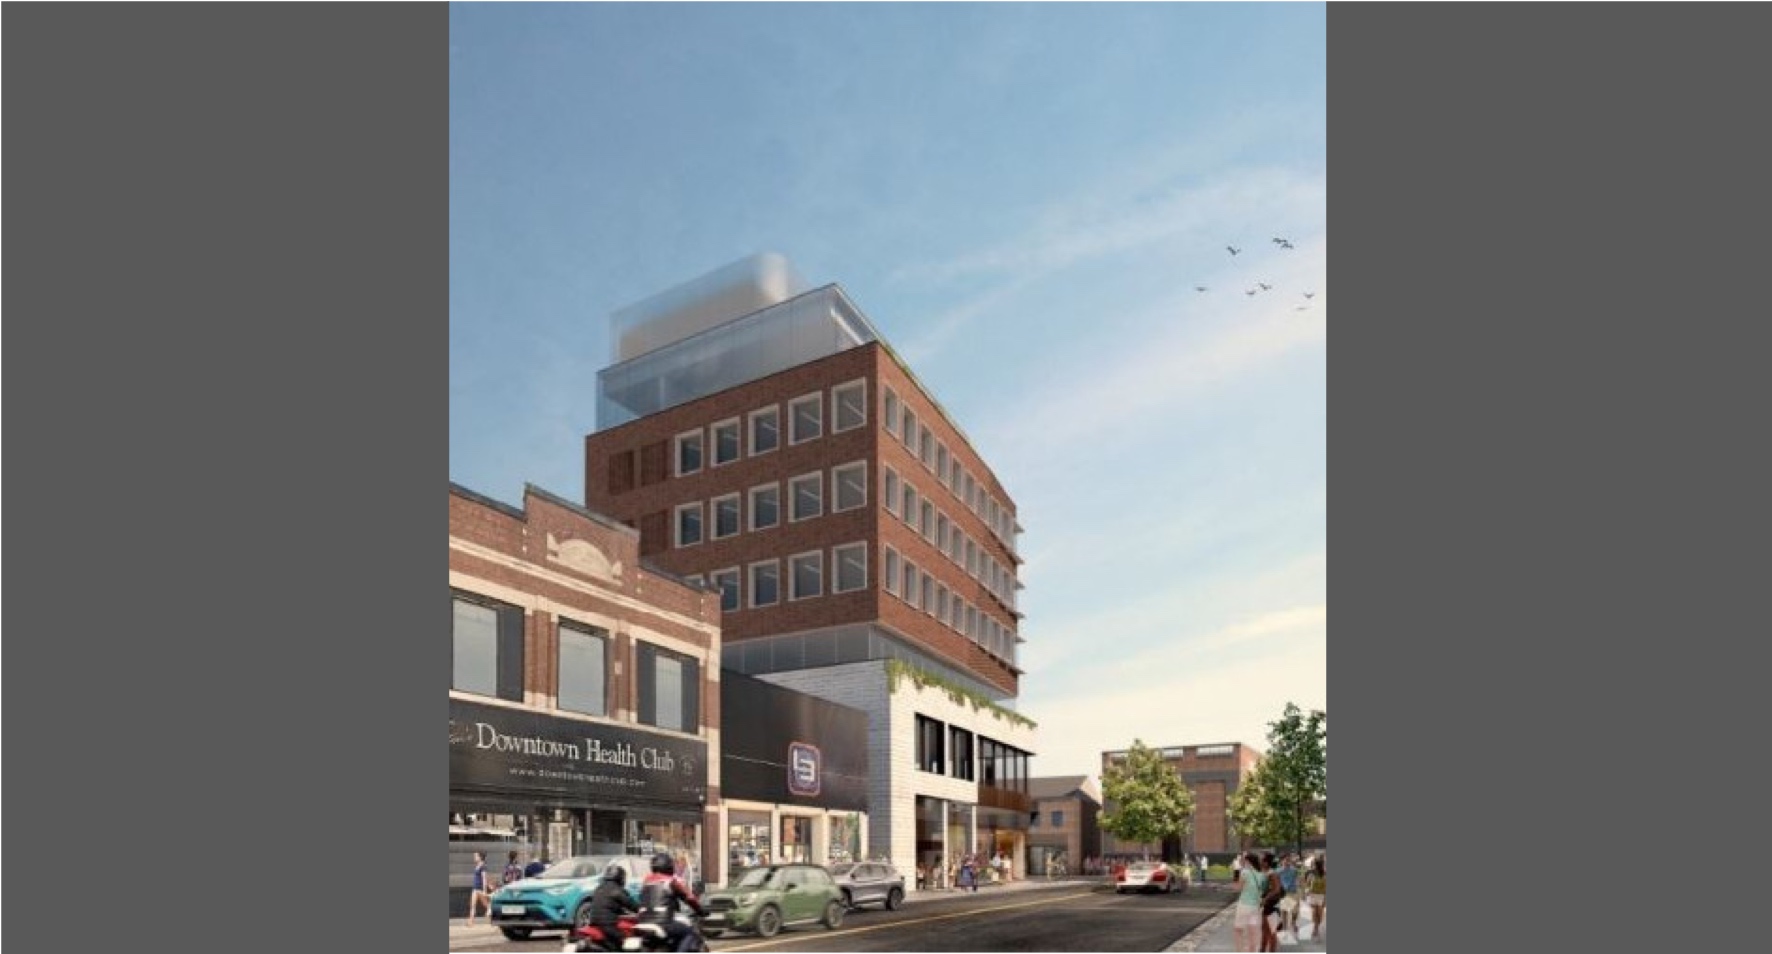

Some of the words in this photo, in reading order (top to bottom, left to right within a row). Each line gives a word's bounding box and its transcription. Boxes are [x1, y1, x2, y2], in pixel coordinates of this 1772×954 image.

[475, 722, 580, 760] Downtown
[586, 738, 636, 768] Health
[640, 747, 674, 772] Club
